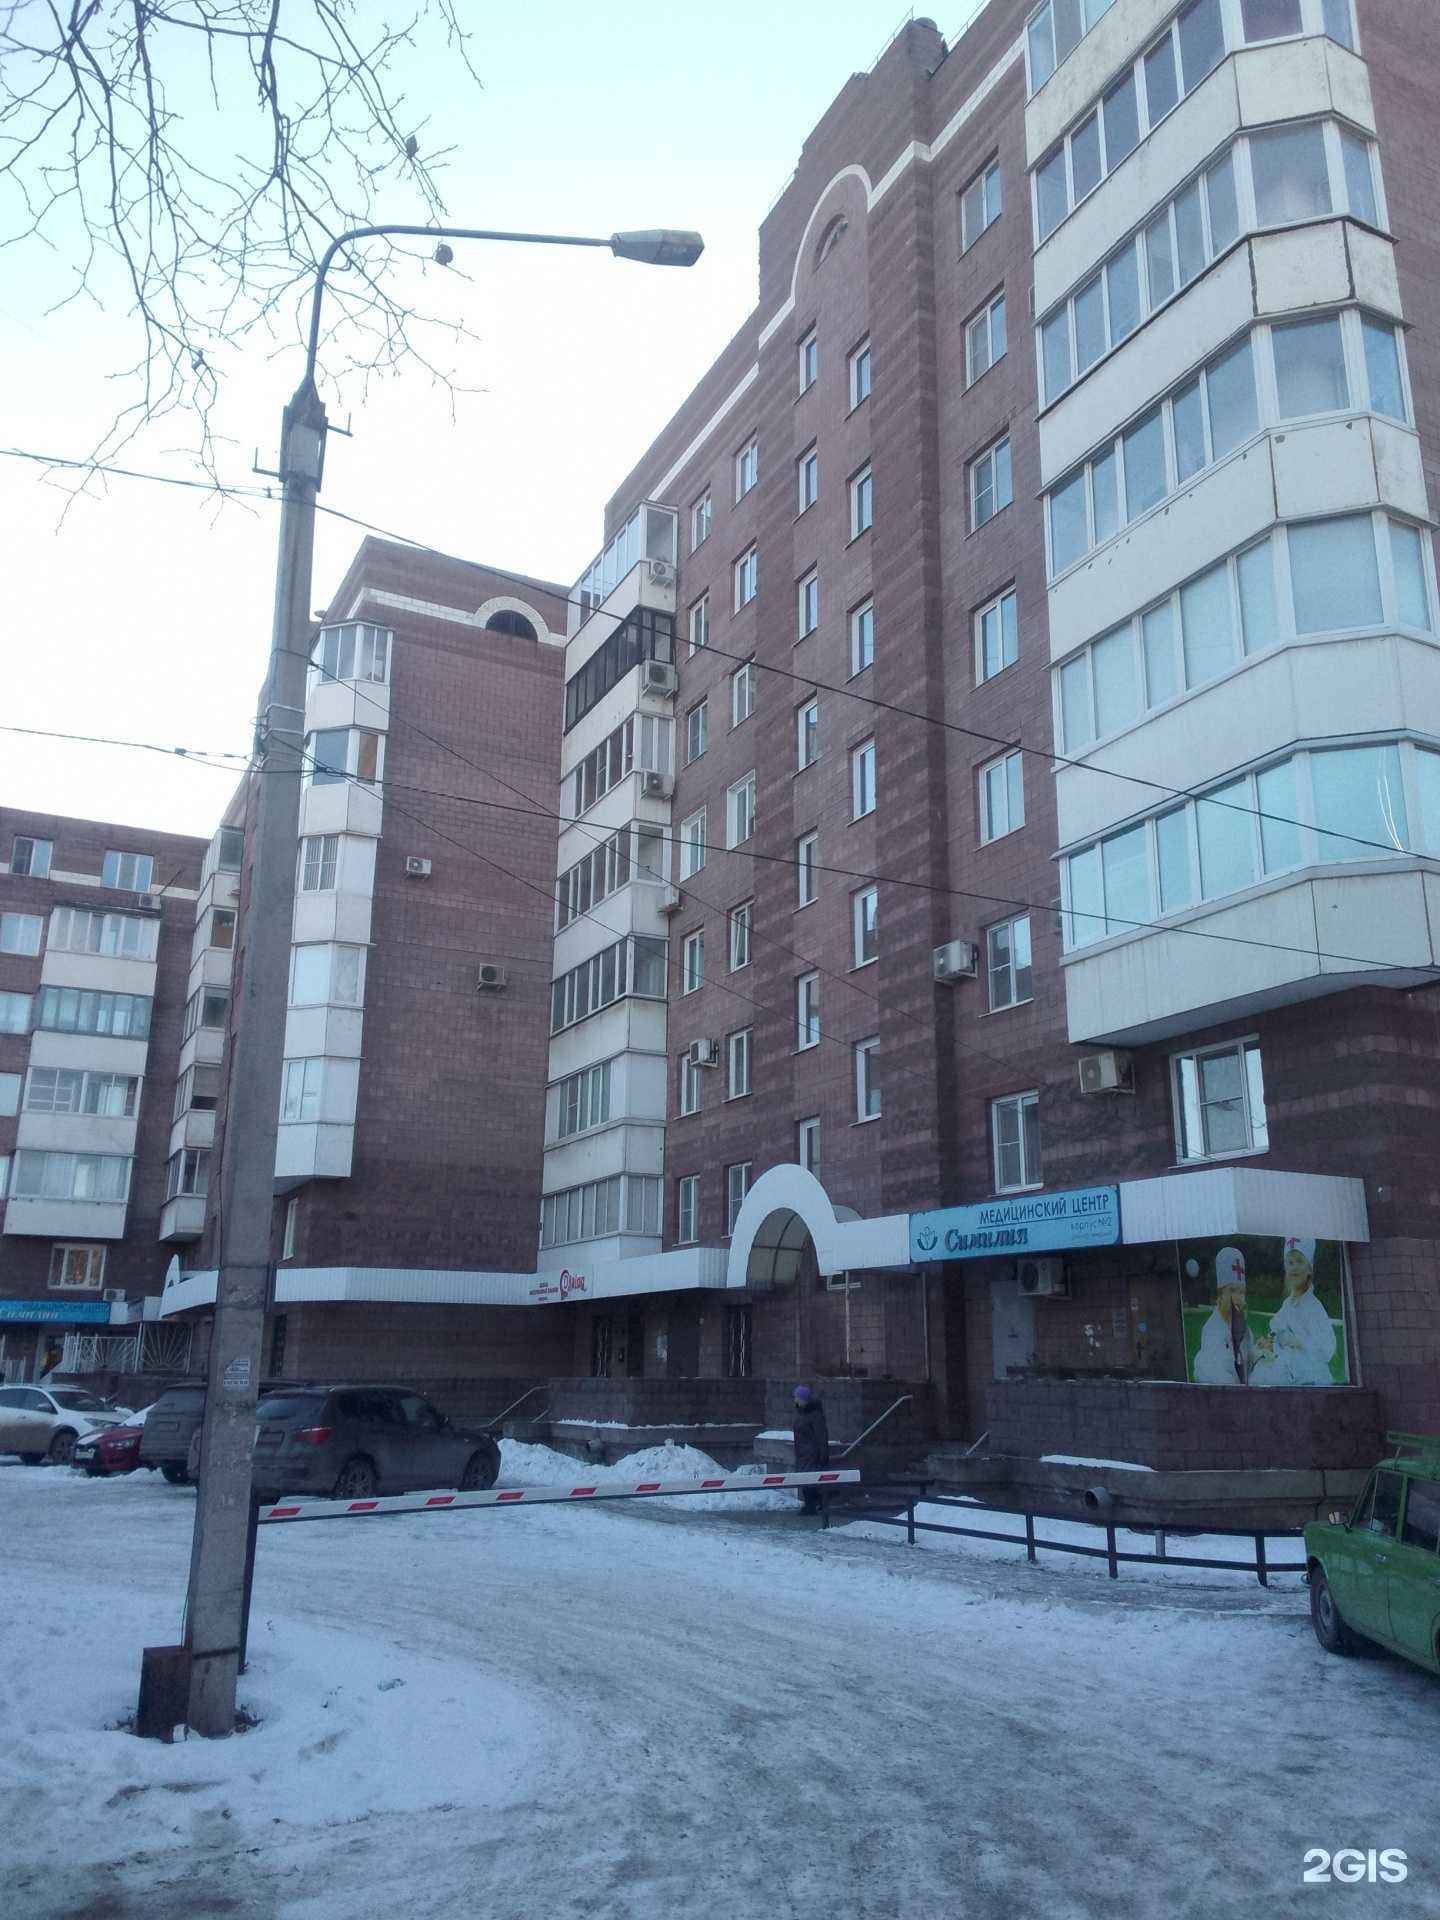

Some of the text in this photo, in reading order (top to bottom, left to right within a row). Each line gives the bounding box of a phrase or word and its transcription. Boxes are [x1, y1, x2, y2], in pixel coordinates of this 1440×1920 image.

[979, 1194, 1109, 1225] МЕДИЦИНСКИЙ ЦЕНТР
[945, 1228, 1028, 1252] Симилия
